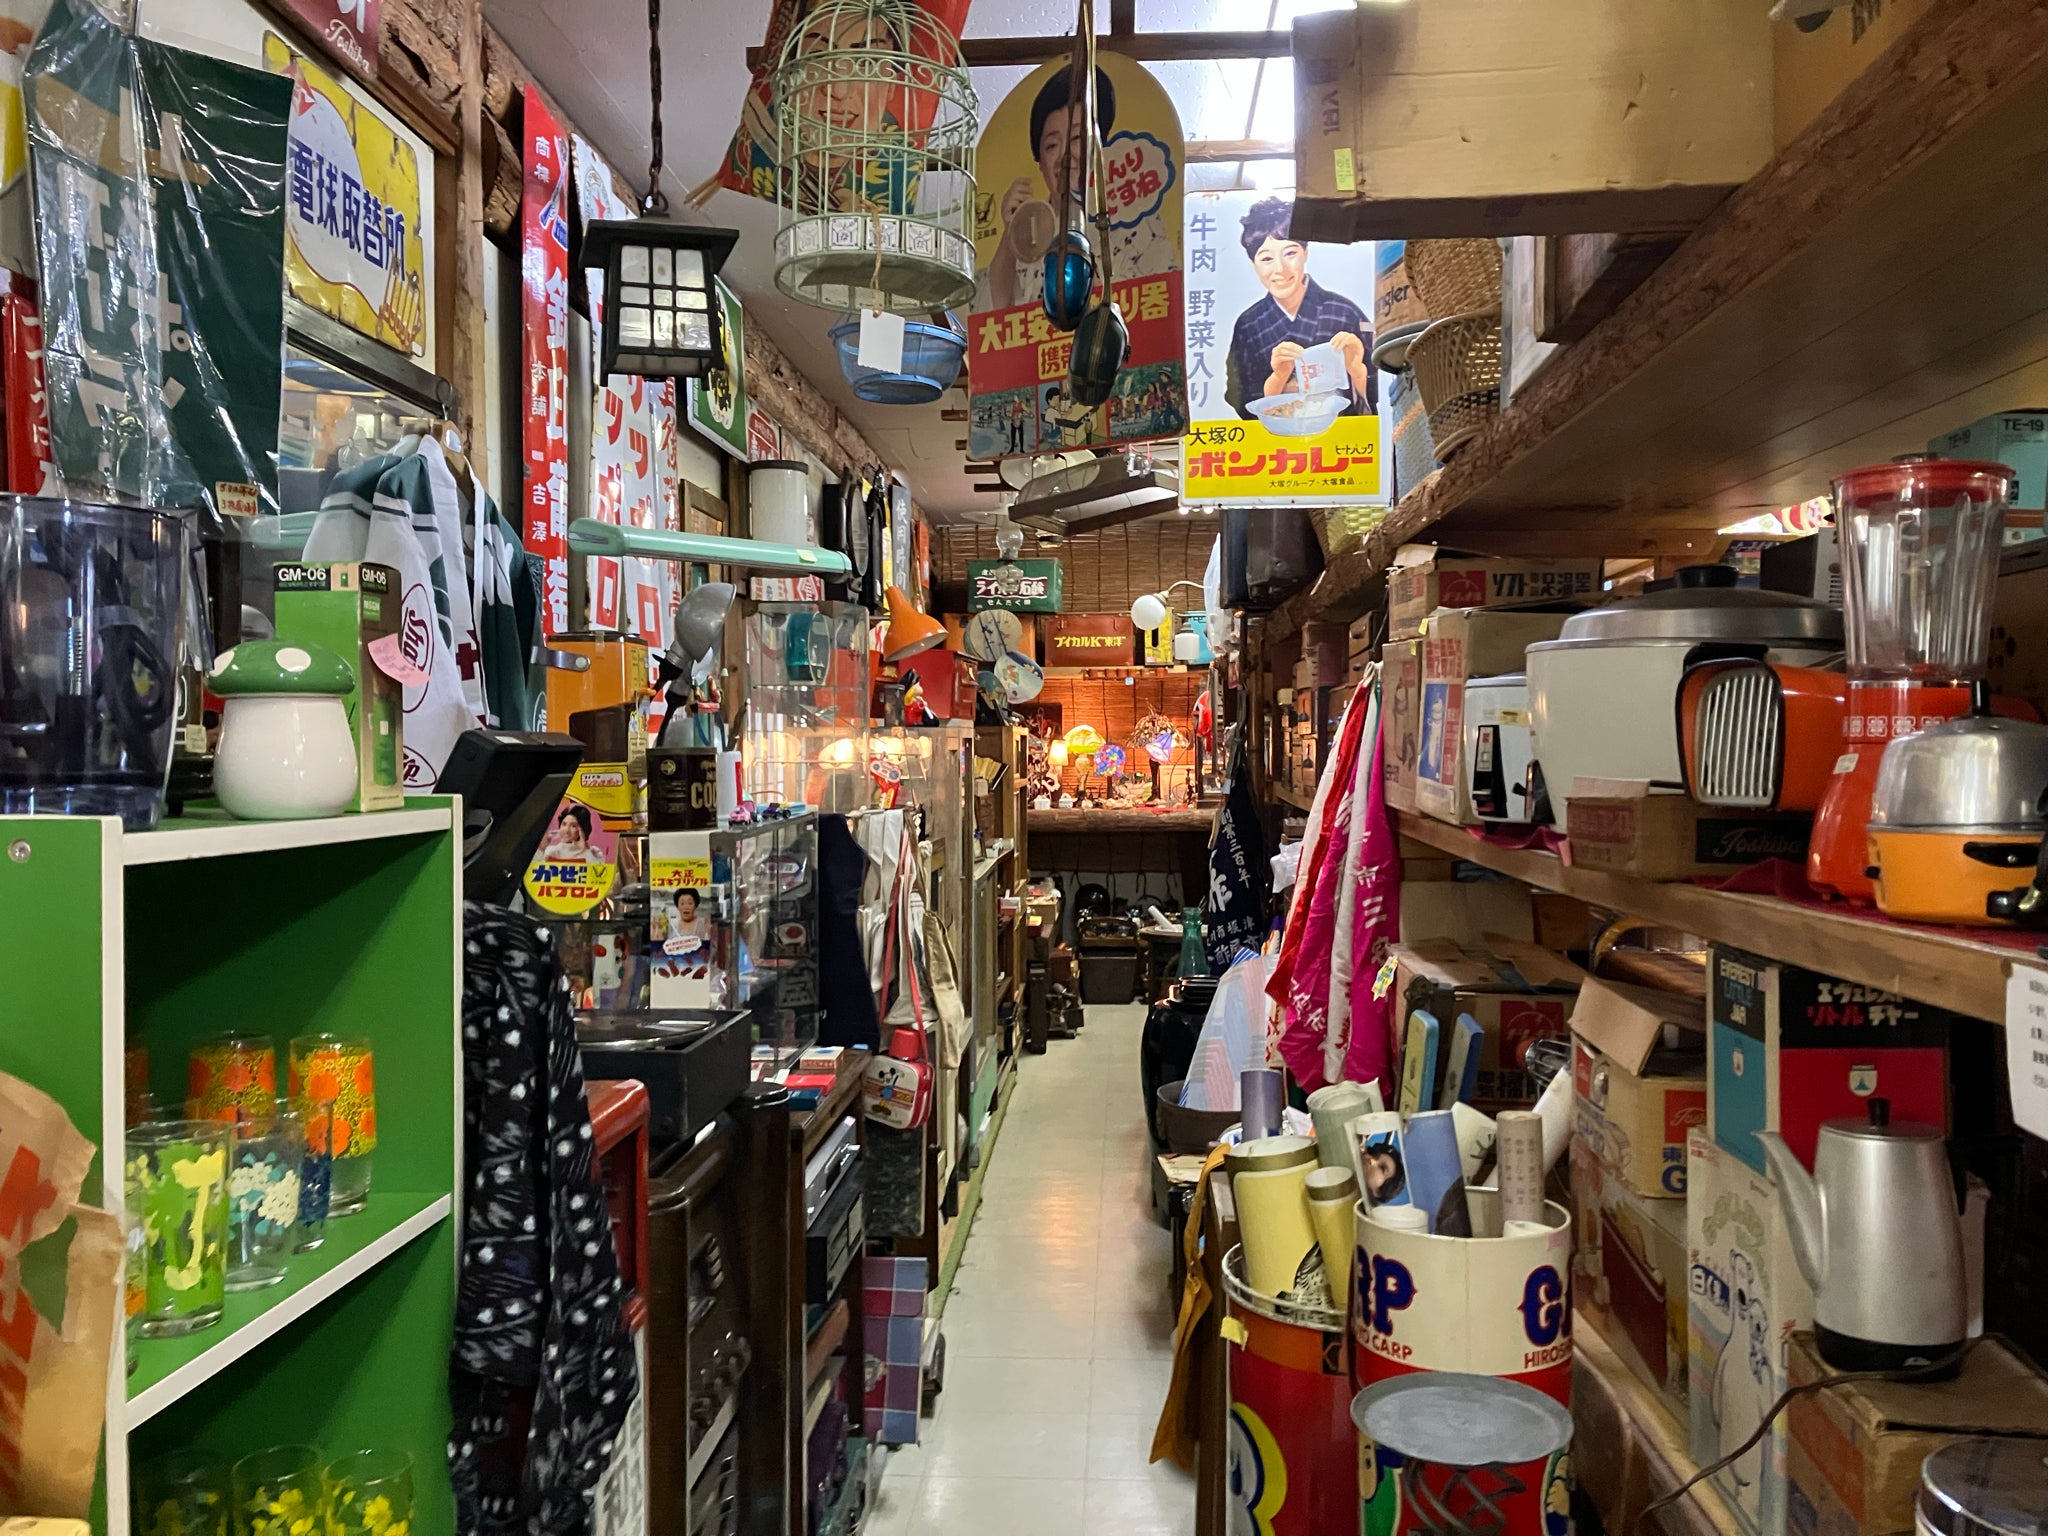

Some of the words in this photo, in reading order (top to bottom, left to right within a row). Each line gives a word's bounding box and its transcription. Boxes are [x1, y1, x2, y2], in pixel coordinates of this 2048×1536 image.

[289, 134, 405, 281] 電球取替所
[1189, 212, 1217, 273] 牛肉
[1187, 289, 1216, 409] 野菜入り
[1189, 426, 1245, 447] 大塚の
[2003, 419, 2045, 432] TE-19
[1188, 446, 1374, 479] ボンカレー
[594, 388, 627, 629] ッポロ
[278, 567, 326, 582] GM-06
[362, 567, 387, 586] GM-06
[1372, 1335, 1413, 1360] CARP
